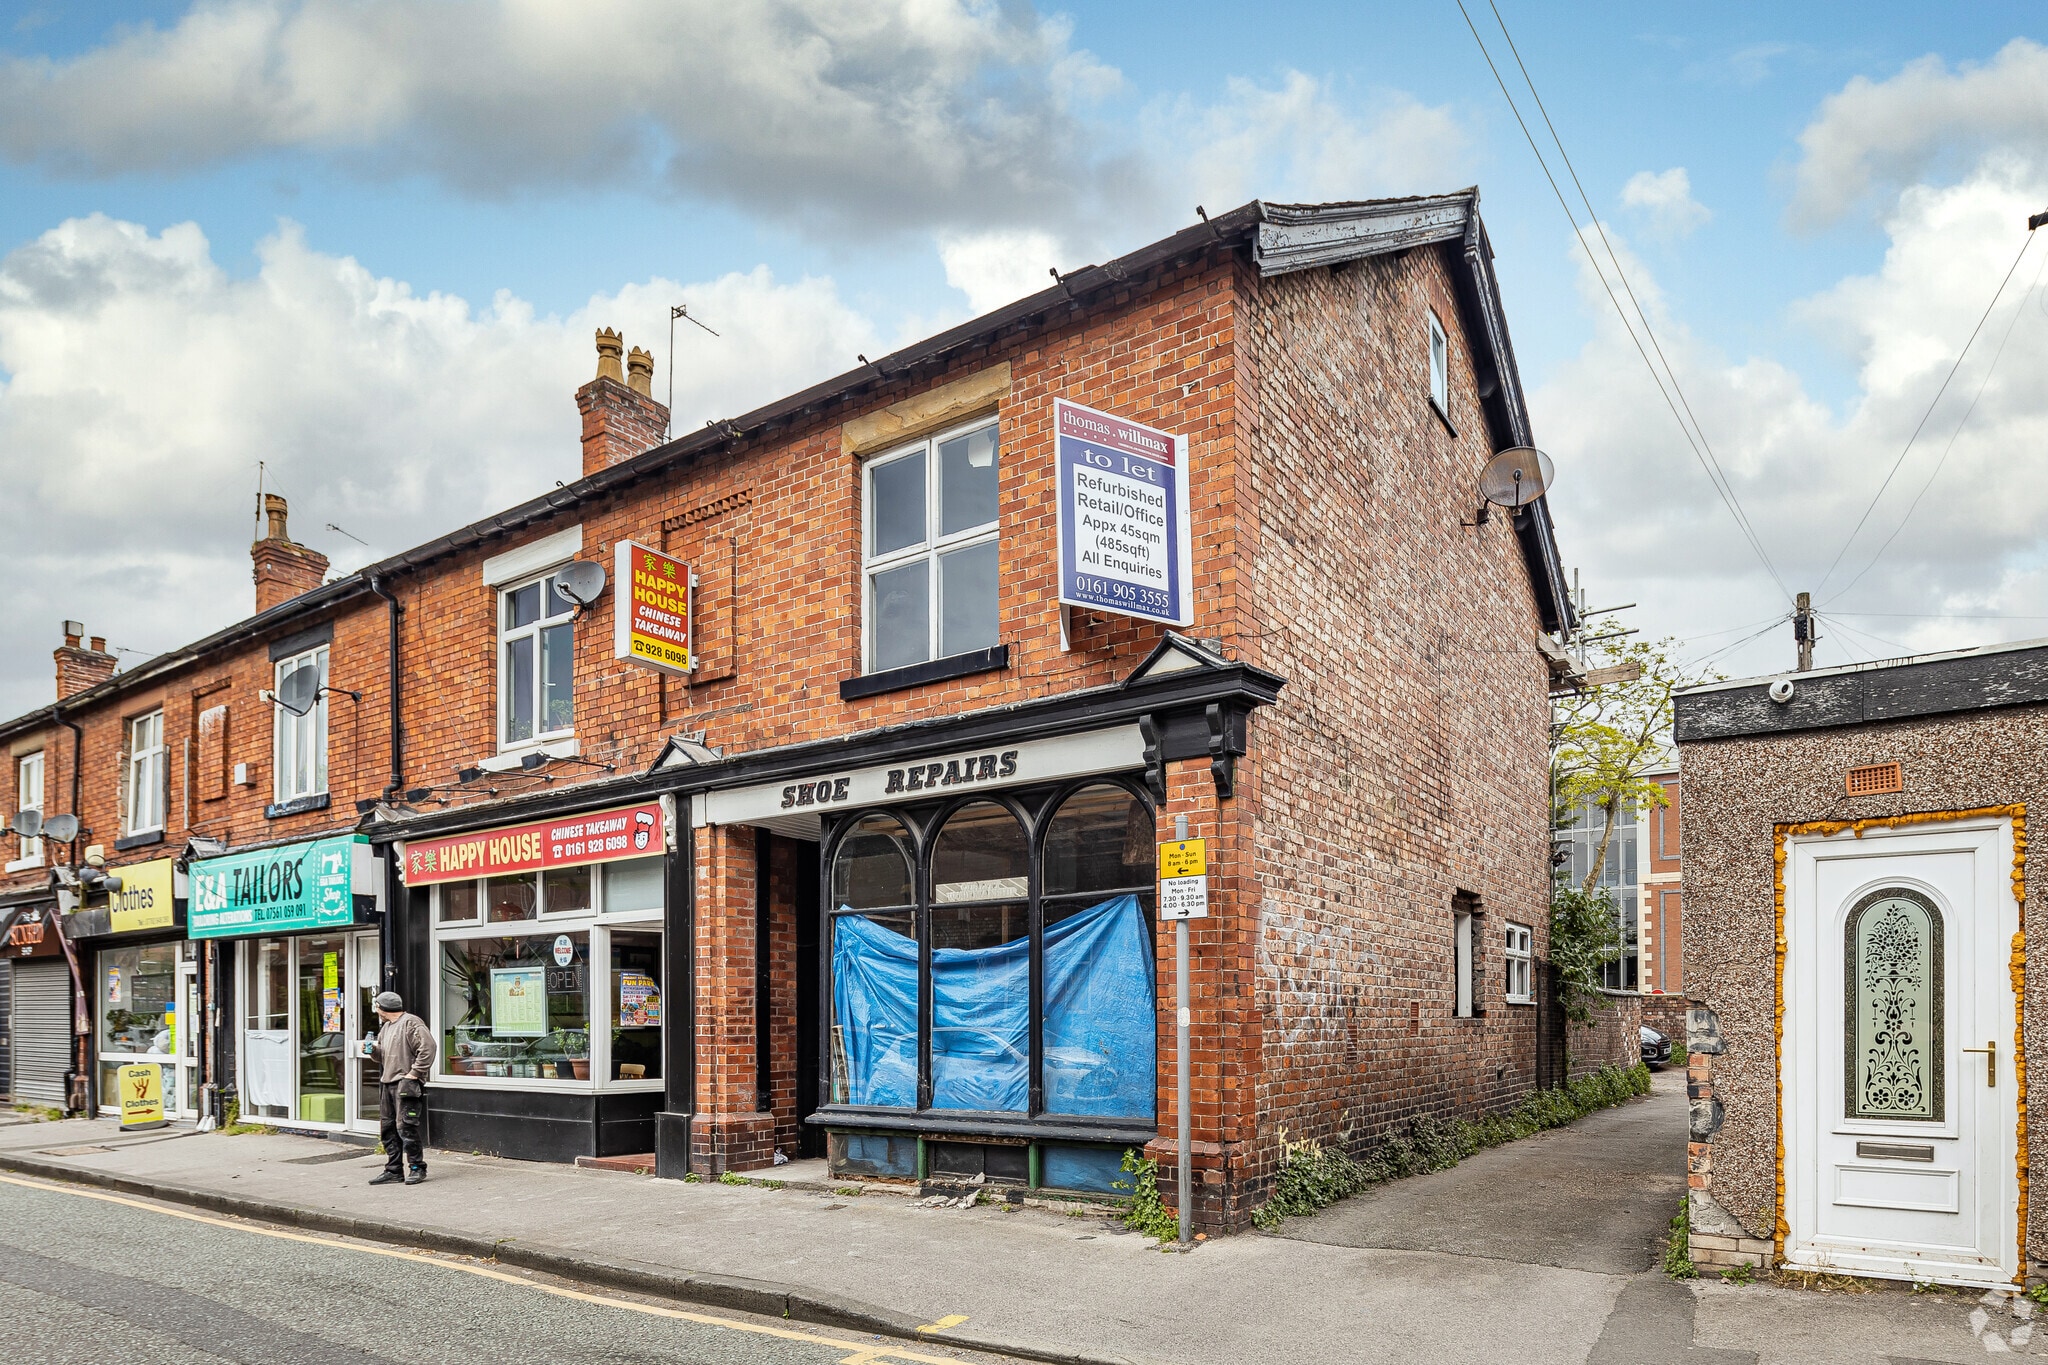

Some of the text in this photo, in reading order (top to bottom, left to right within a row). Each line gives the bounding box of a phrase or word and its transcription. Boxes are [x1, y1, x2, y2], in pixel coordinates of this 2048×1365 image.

[1063, 410, 1110, 436] thomas
[1117, 428, 1168, 454] willmax
[1083, 449, 1113, 468] to
[1121, 456, 1157, 482] let
[1077, 472, 1163, 508] Refurbished
[1078, 493, 1164, 527] Retail/Office
[1082, 514, 1160, 544] Appx 45sqm
[1095, 535, 1150, 561] (485sqft)
[1082, 550, 1162, 579] All Enquiries
[635, 569, 687, 599] HAPPY
[1076, 576, 1169, 608] 0161 905 3555
[634, 585, 687, 616] HOUSE
[1075, 591, 1170, 616] www.thomaswillmax.co.uk
[634, 617, 687, 643] TAKEAWAY
[639, 605, 681, 628] CHINESE
[645, 643, 687, 665] 928 6098
[781, 750, 1019, 808] SHOE REPAIRS
[551, 817, 628, 841] CHINESE TAKEAWAY
[439, 832, 542, 872] HAPPY HOUSE
[565, 835, 628, 857] 0161 928 6098
[112, 884, 154, 913] Clothes
[195, 857, 304, 912] E&A TAILORS
[323, 887, 341, 903] Shop
[266, 906, 282, 920] 07561
[284, 904, 294, 918] 059
[295, 903, 306, 917] 091
[550, 971, 580, 988] OPEN
[128, 1069, 151, 1078] Cash
[125, 1098, 159, 1108] Clothes
